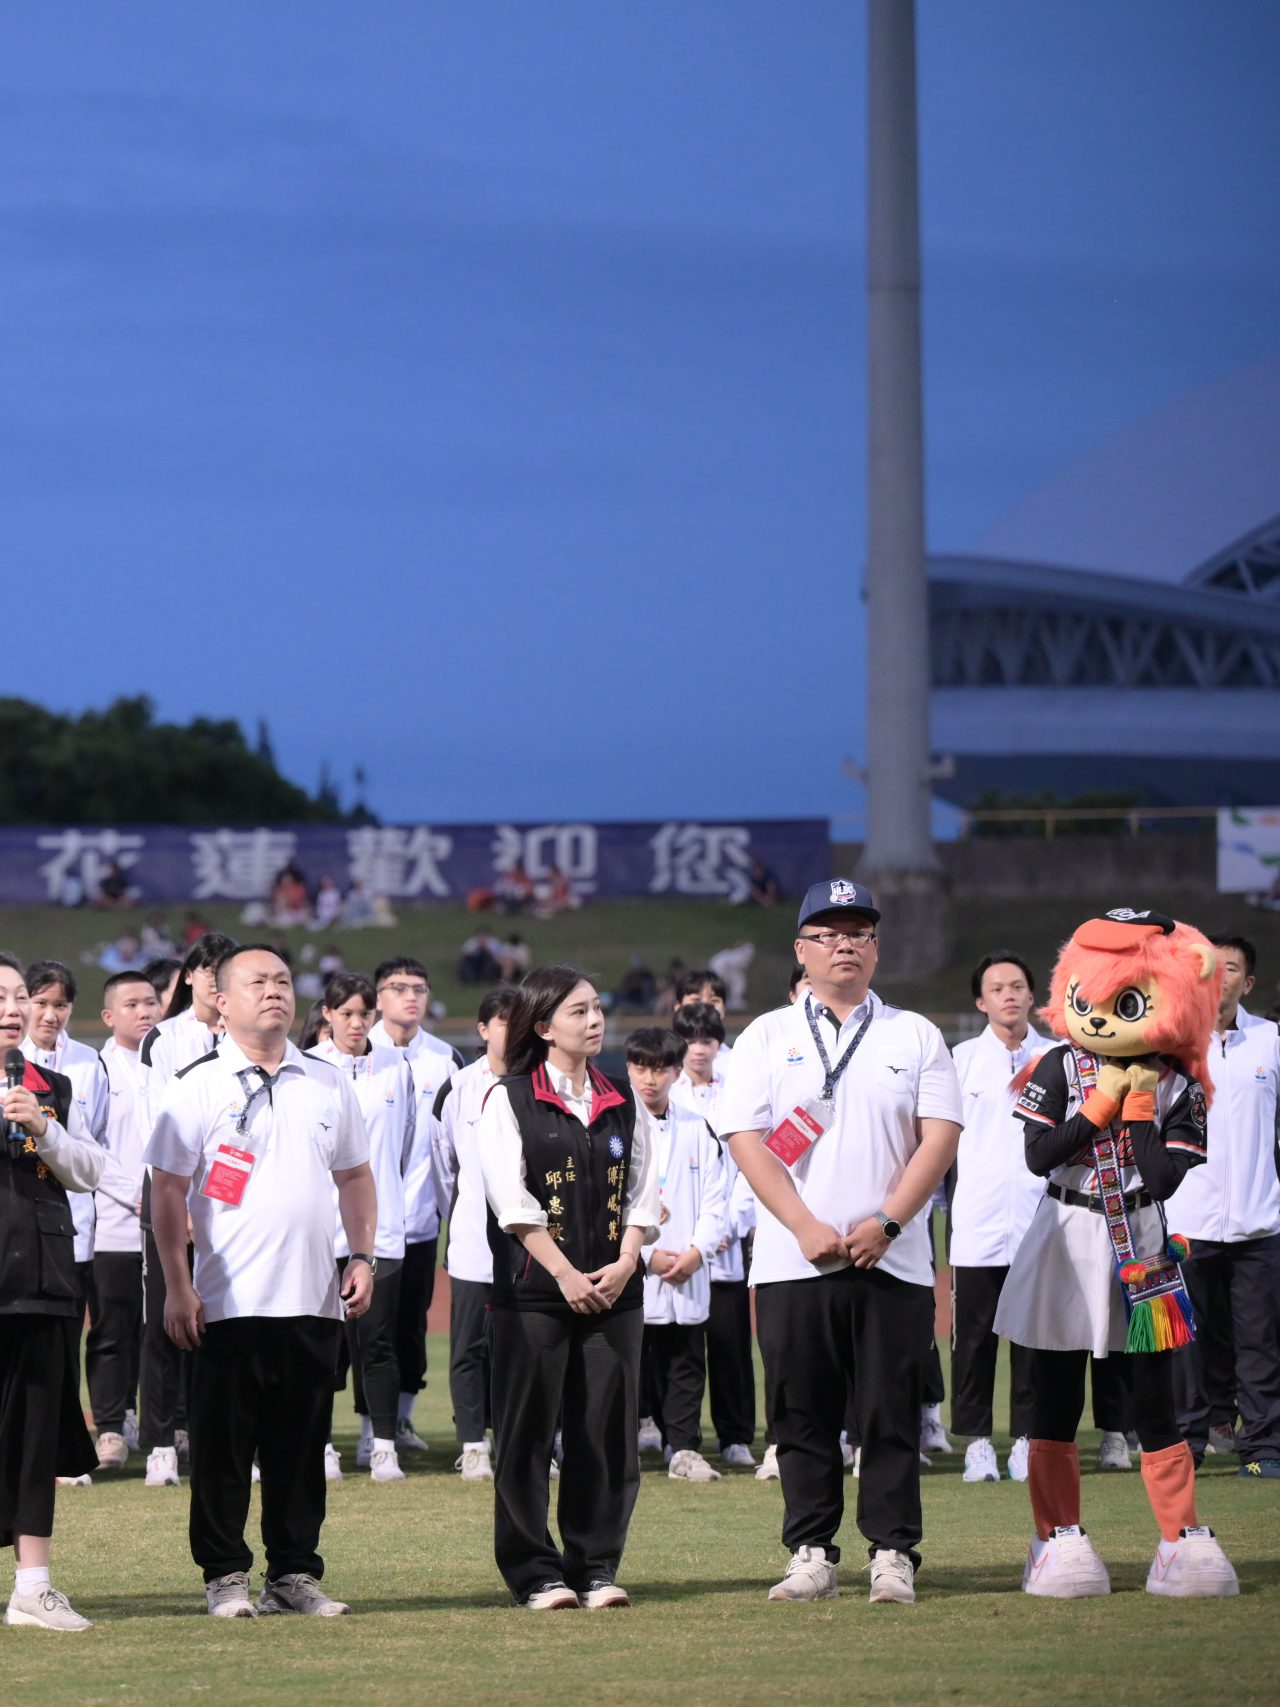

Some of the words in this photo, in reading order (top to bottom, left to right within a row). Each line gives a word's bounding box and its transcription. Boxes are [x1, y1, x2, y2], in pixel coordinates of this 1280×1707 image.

[36, 824, 752, 904] 花蓮歡迎您
[565, 1156, 576, 1183] 主任
